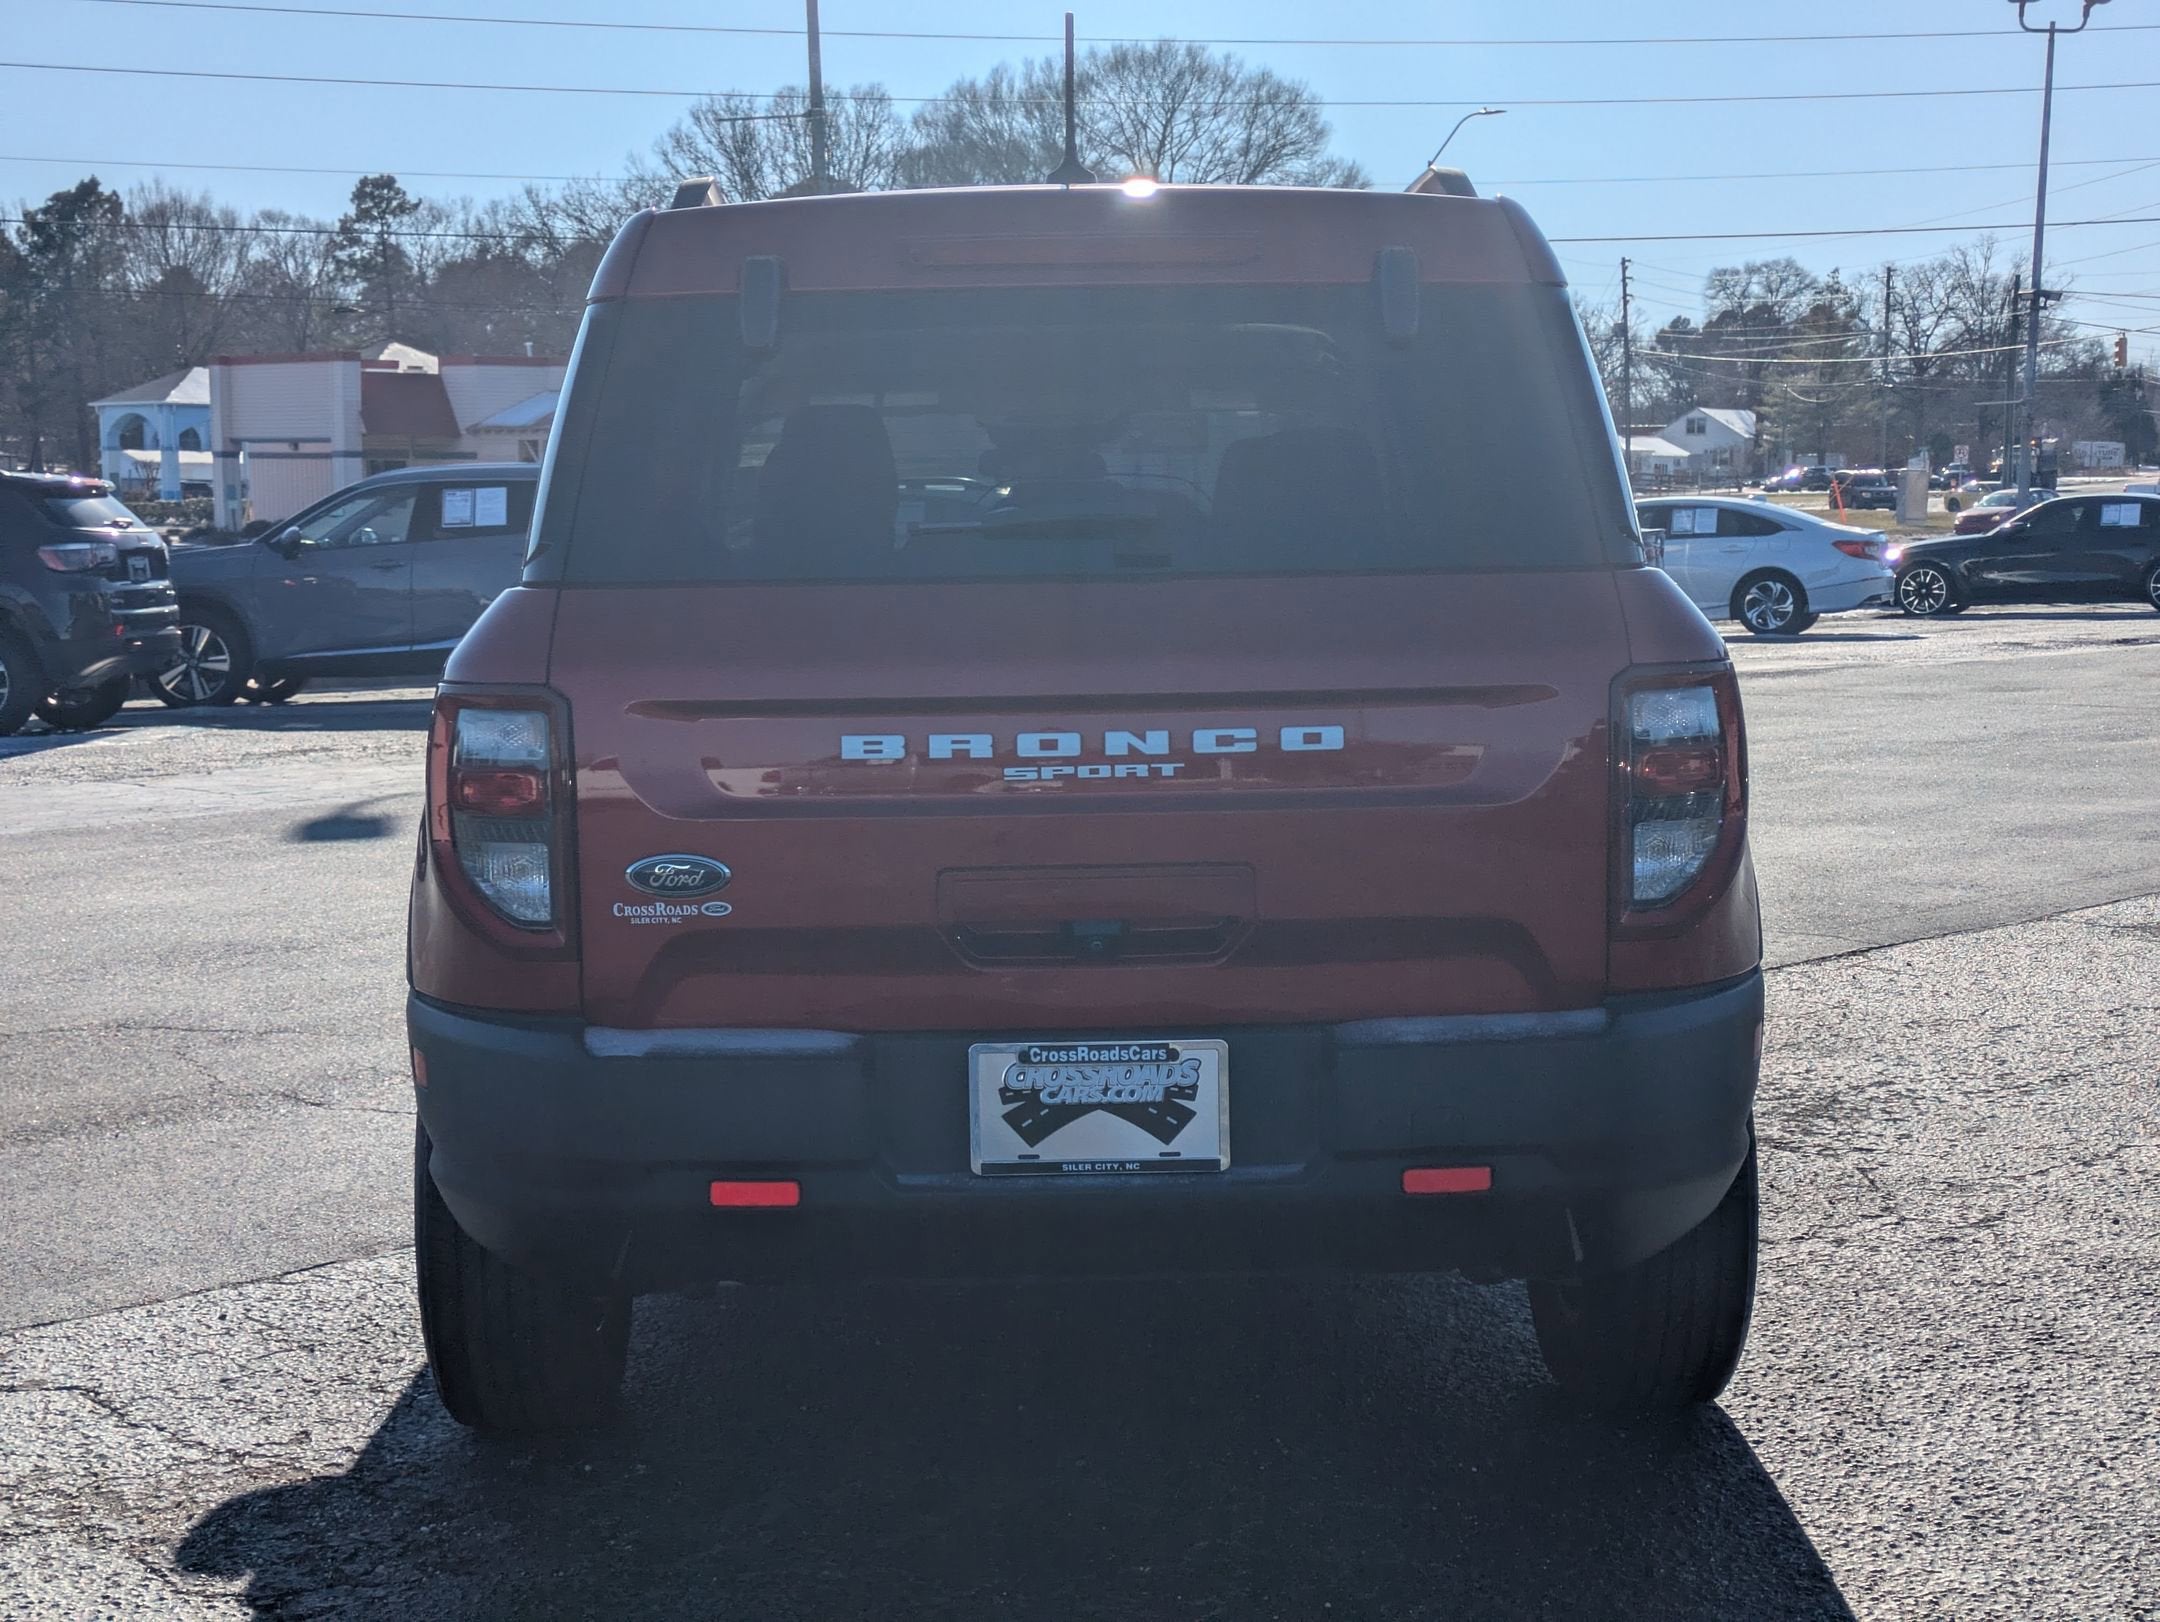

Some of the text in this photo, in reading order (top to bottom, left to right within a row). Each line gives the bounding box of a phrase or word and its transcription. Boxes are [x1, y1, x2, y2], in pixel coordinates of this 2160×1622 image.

[841, 725, 1344, 760] BRONCO
[1003, 763, 1185, 781] SPORT
[650, 863, 705, 887] Ford
[630, 917, 650, 925] SILER
[651, 917, 670, 925] CITY,
[1029, 1045, 1167, 1063] CrossRoadsCars
[1002, 1058, 1201, 1090] CROSSROADS
[1040, 1086, 1165, 1105] CARS.COM
[1062, 1162, 1140, 1171] SILER CITY, NC
